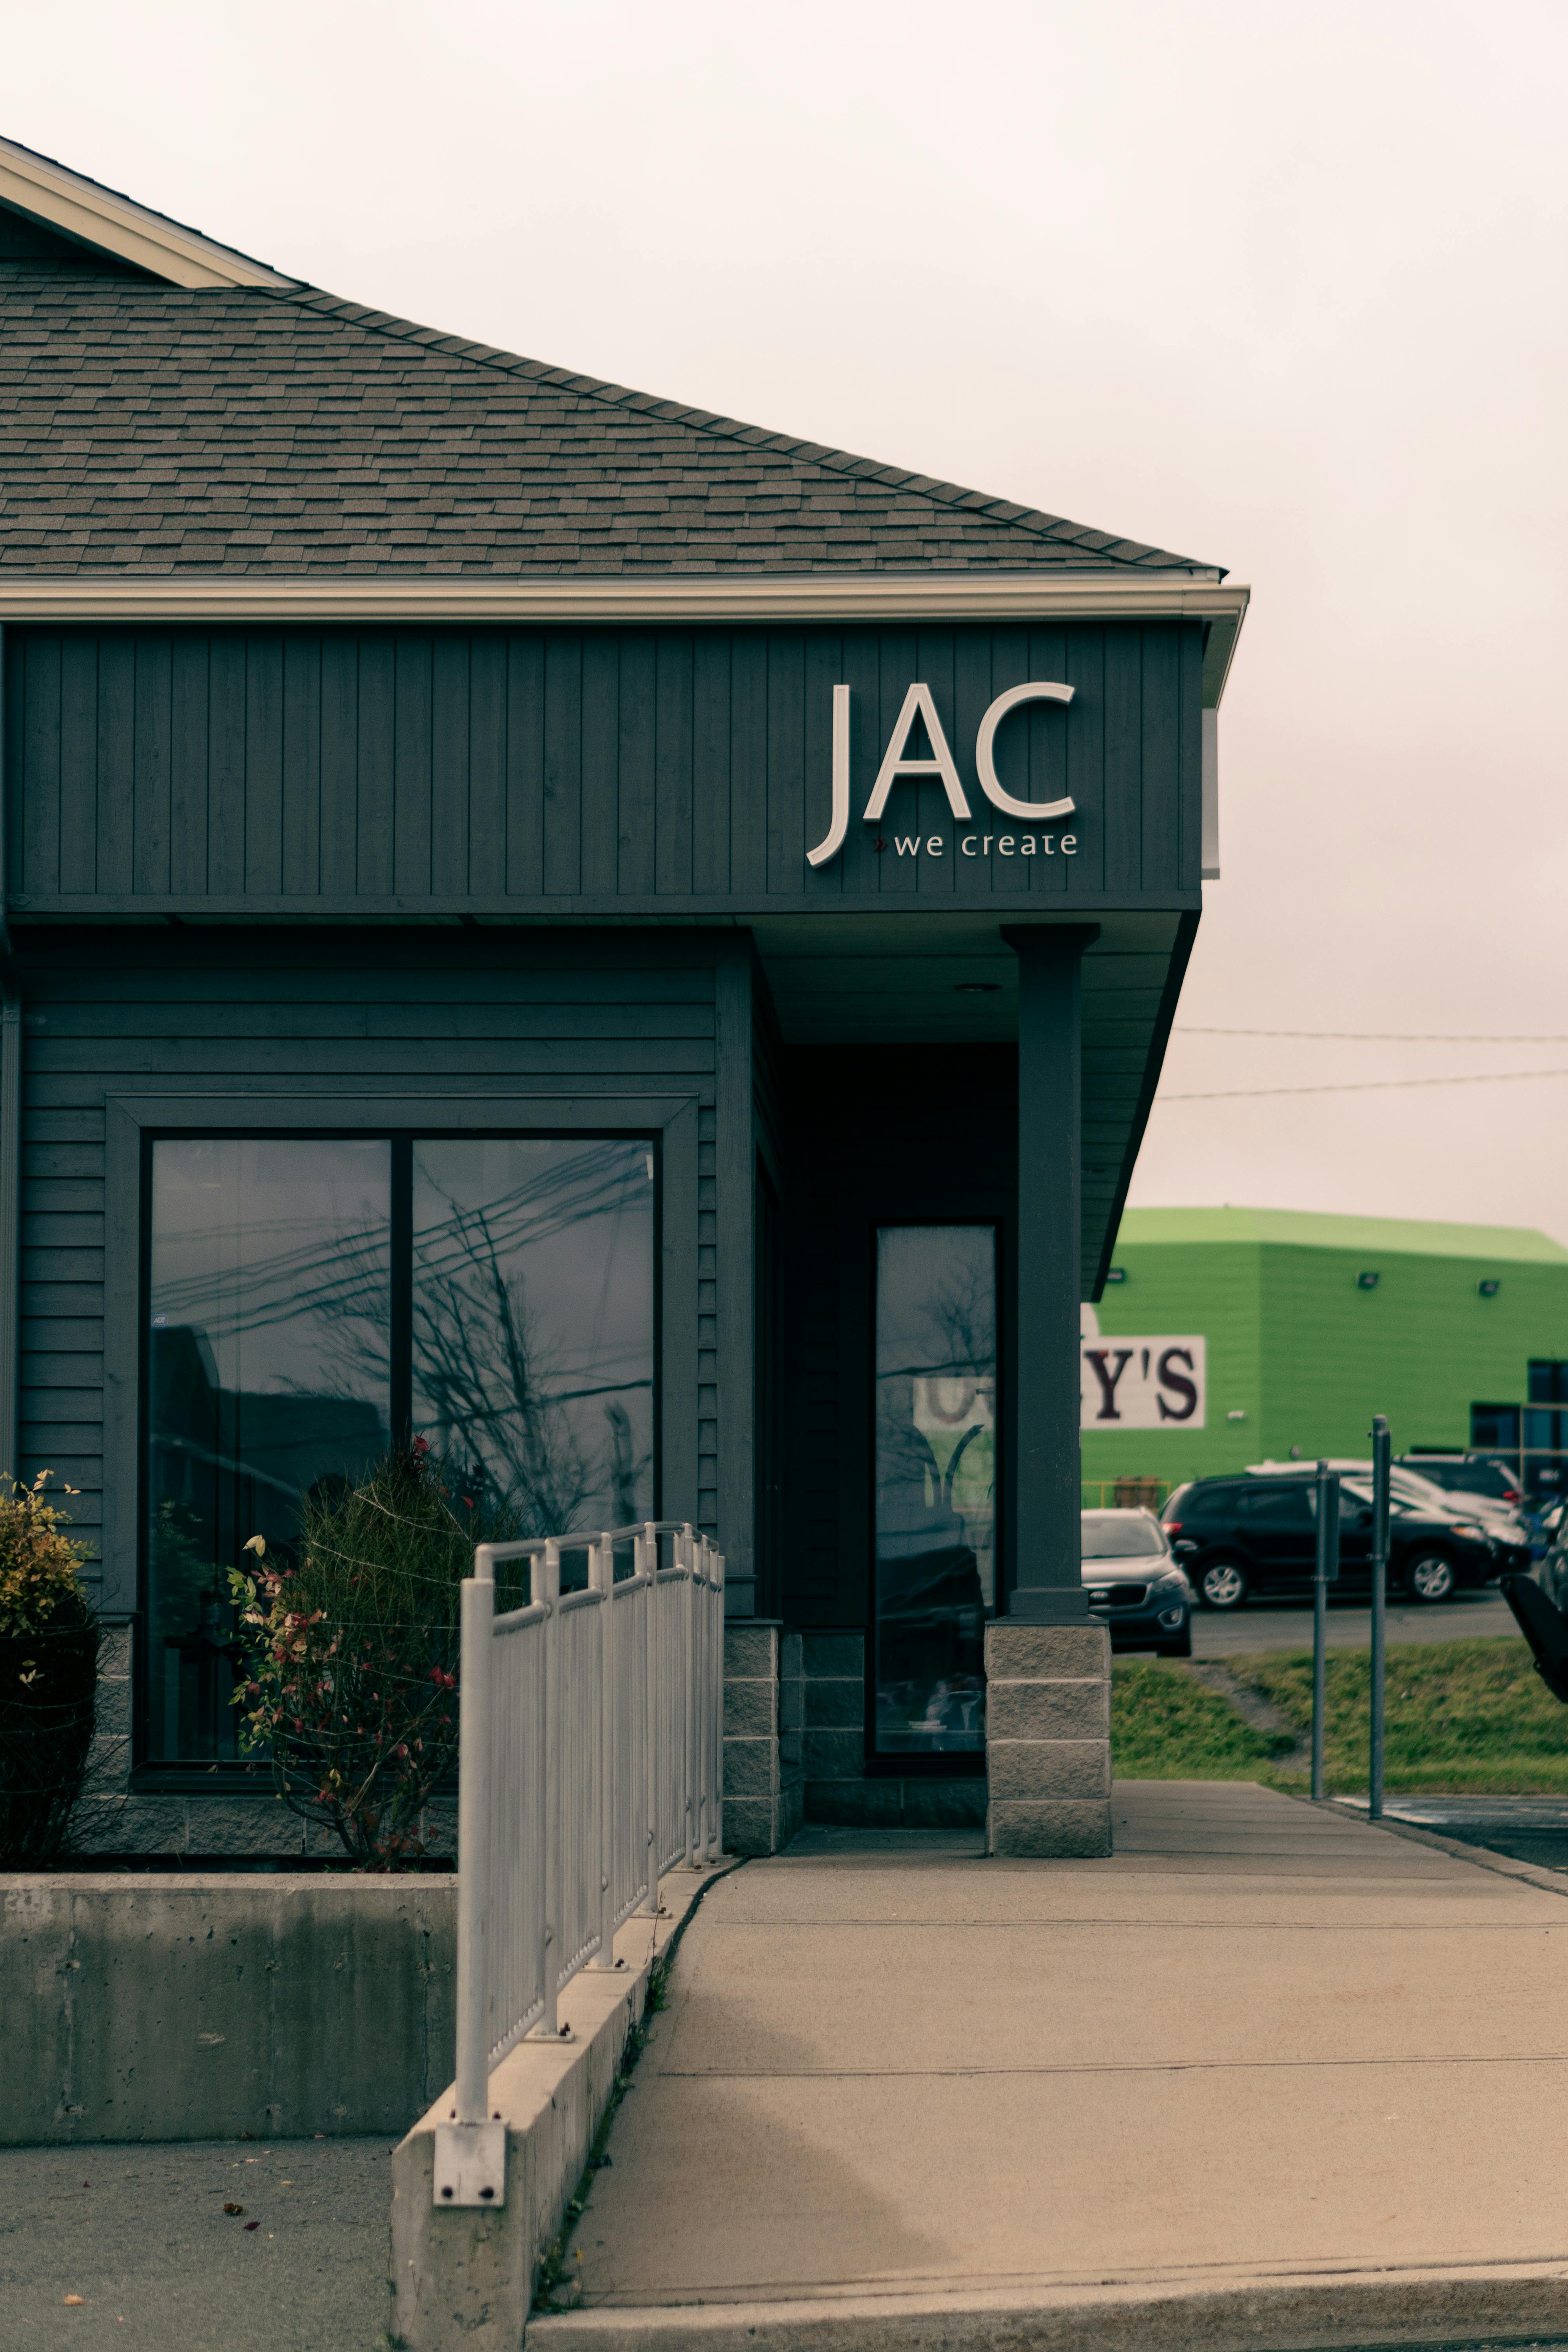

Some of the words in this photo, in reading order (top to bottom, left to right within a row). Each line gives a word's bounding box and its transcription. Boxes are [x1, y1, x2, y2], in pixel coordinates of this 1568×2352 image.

[806, 681, 1076, 869] JAC
[894, 836, 943, 856] we
[962, 835, 1077, 856] create
[1081, 1347, 1198, 1421] Y'S
